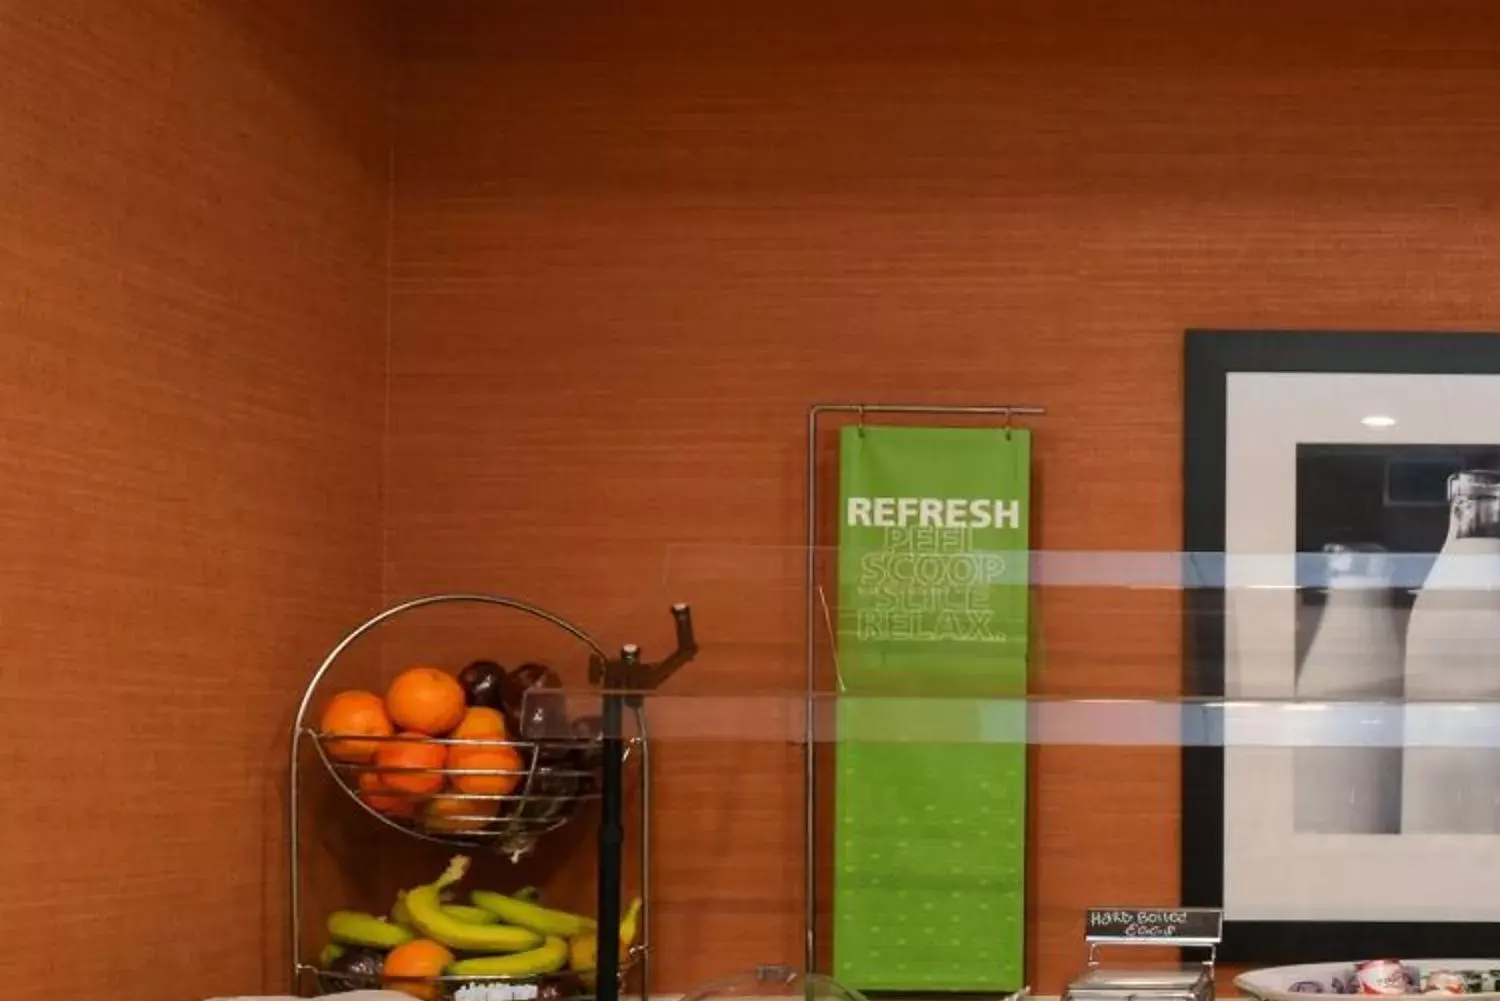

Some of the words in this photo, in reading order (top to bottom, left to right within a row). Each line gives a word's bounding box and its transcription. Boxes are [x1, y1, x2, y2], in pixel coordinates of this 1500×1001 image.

[847, 497, 1020, 529] REFRESH
[860, 553, 1006, 586] SCOOP
[857, 610, 1007, 642] RELAX.
